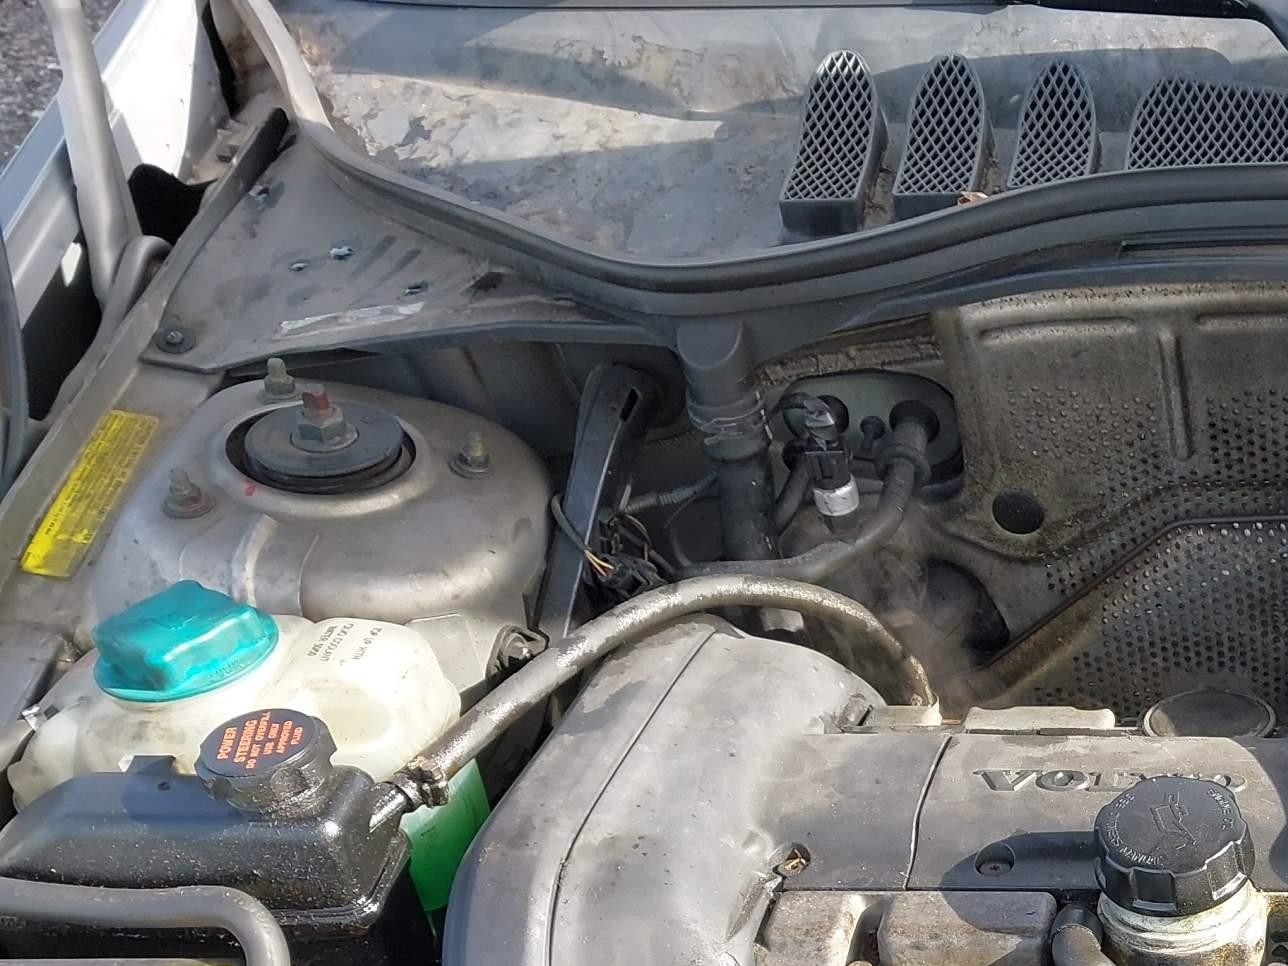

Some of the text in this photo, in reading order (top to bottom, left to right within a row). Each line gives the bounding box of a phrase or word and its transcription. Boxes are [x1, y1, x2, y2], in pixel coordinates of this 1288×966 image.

[216, 727, 238, 760] POWER
[233, 719, 258, 763] STEERING
[275, 720, 293, 754] APPROVED
[290, 726, 304, 745] FLUID
[245, 758, 257, 769] DO
[250, 743, 262, 758] NOT
